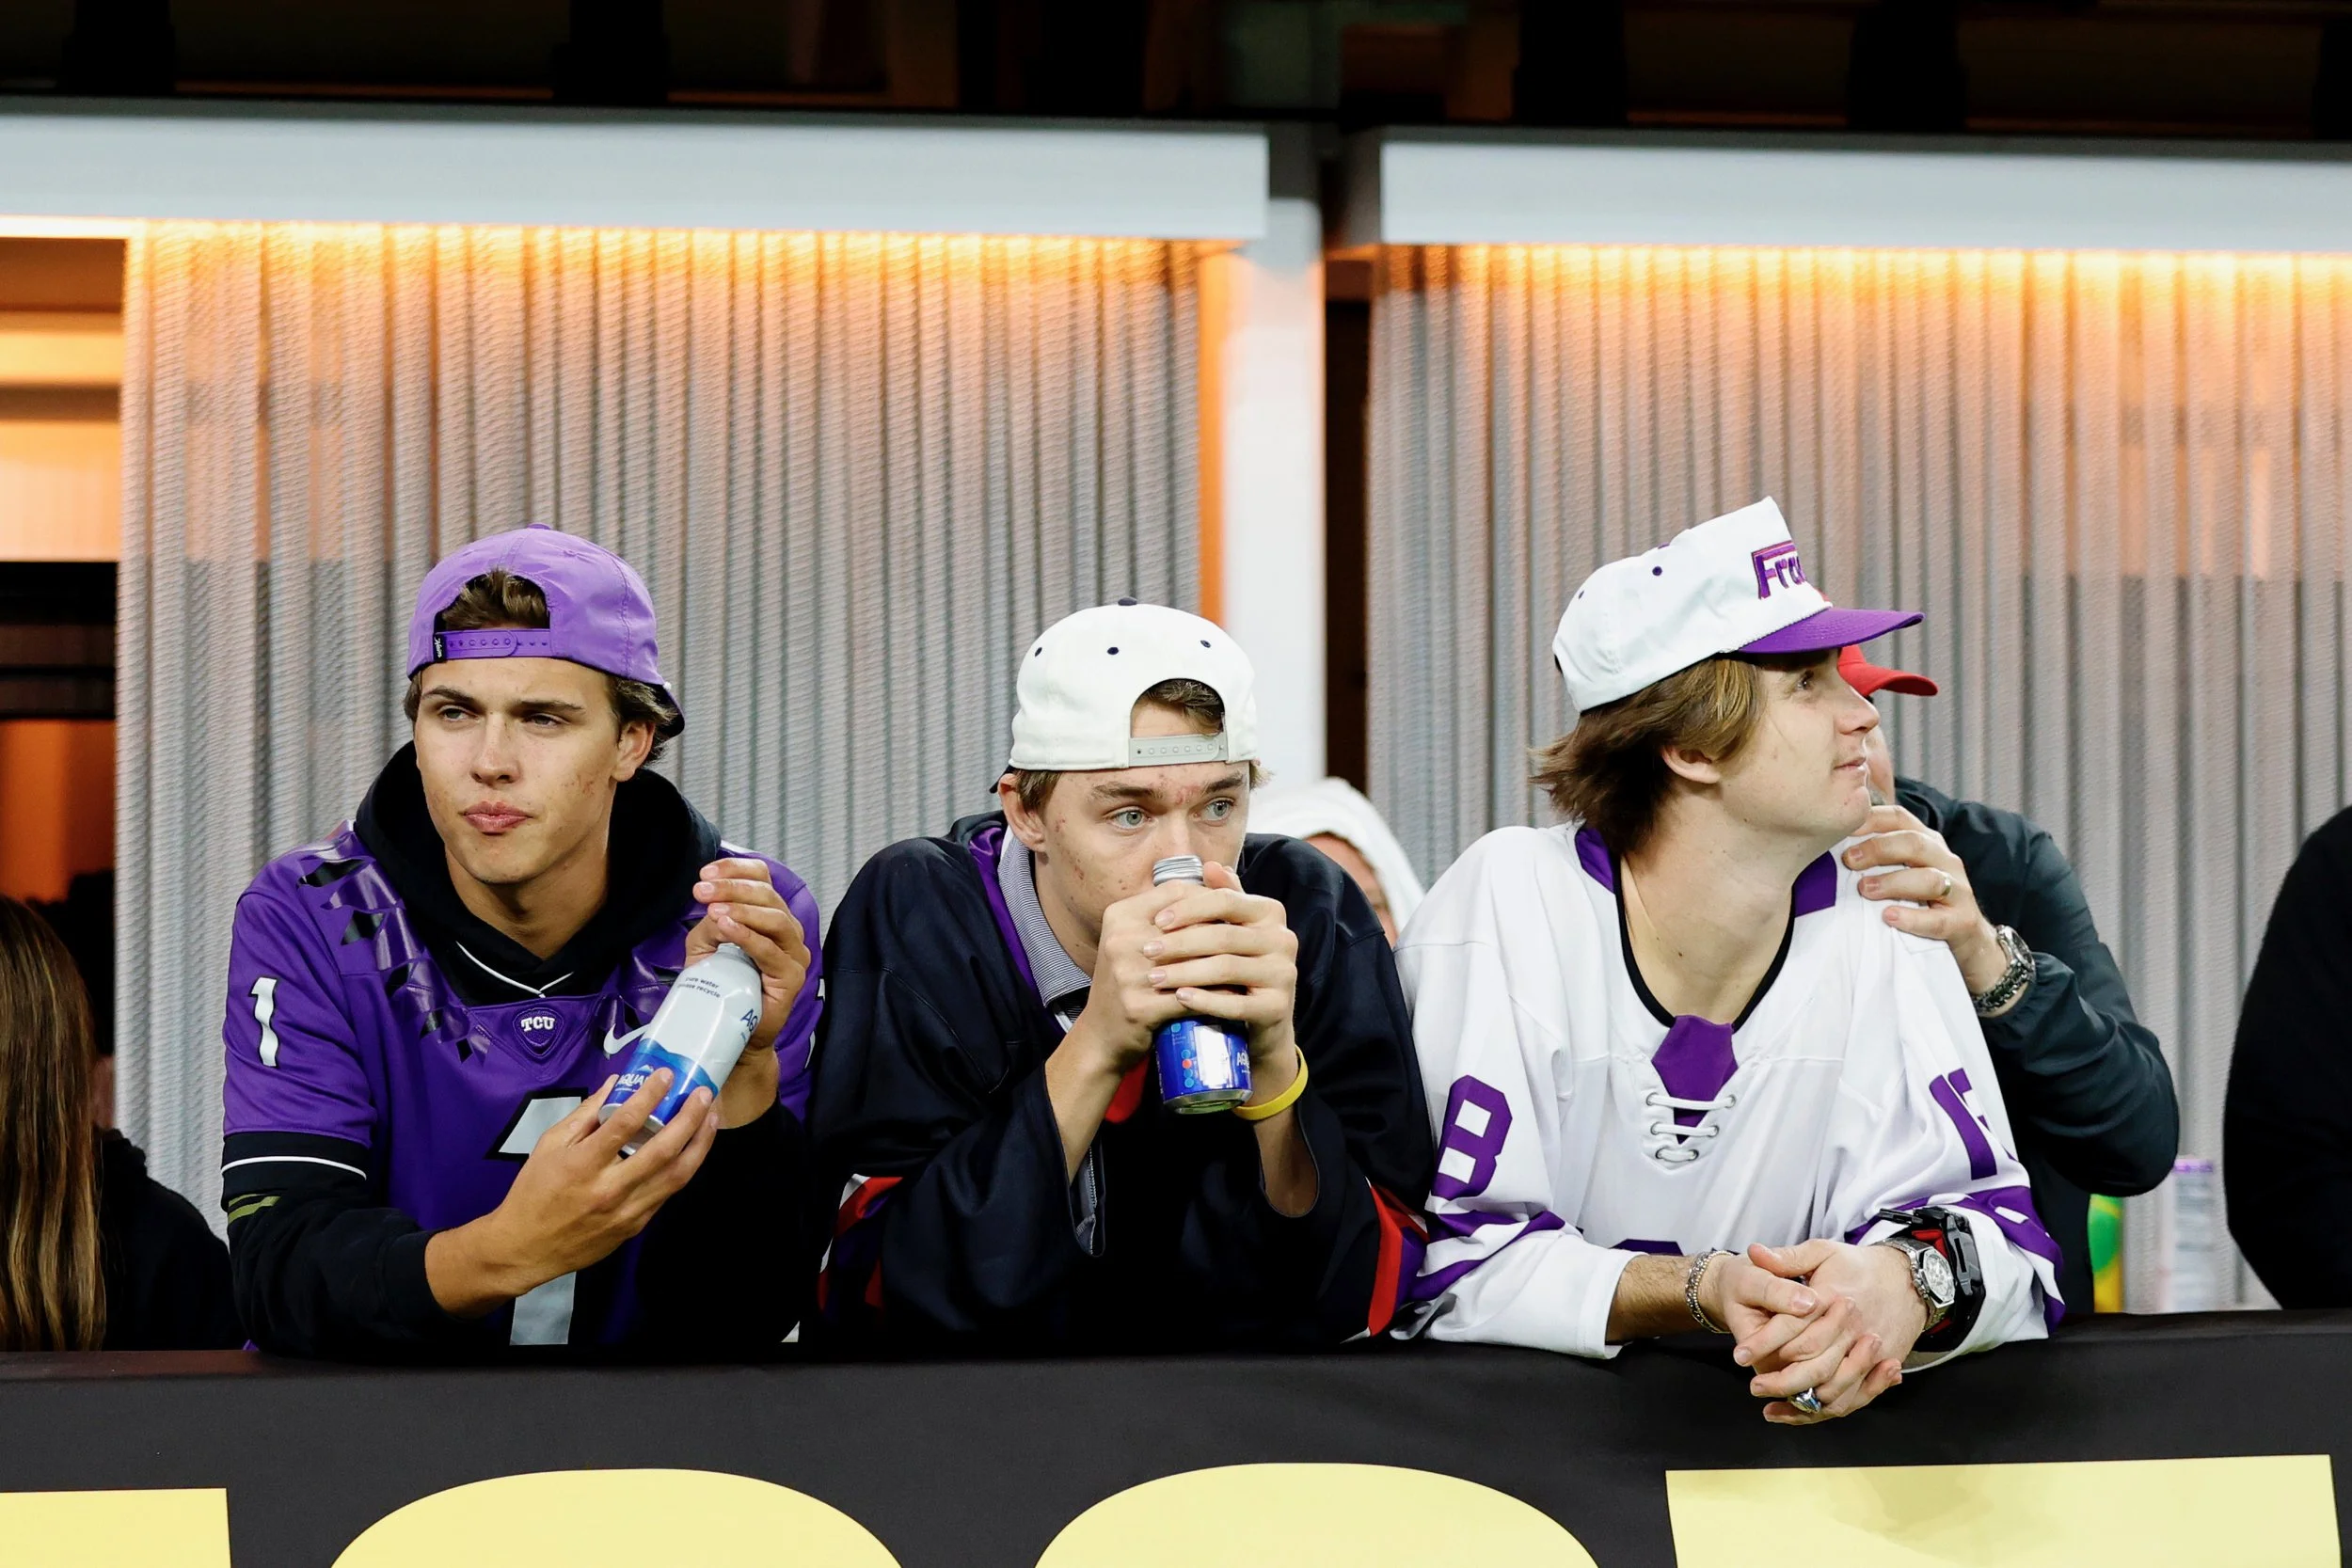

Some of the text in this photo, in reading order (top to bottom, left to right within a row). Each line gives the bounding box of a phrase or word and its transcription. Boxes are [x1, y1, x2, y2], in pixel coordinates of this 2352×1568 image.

[700, 979, 720, 989] water
[696, 986, 721, 998] recycle
[249, 976, 280, 1069] 1
[520, 1016, 556, 1033] TCU
[615, 1073, 648, 1087] AQUA
[1431, 1074, 1513, 1201] 8
